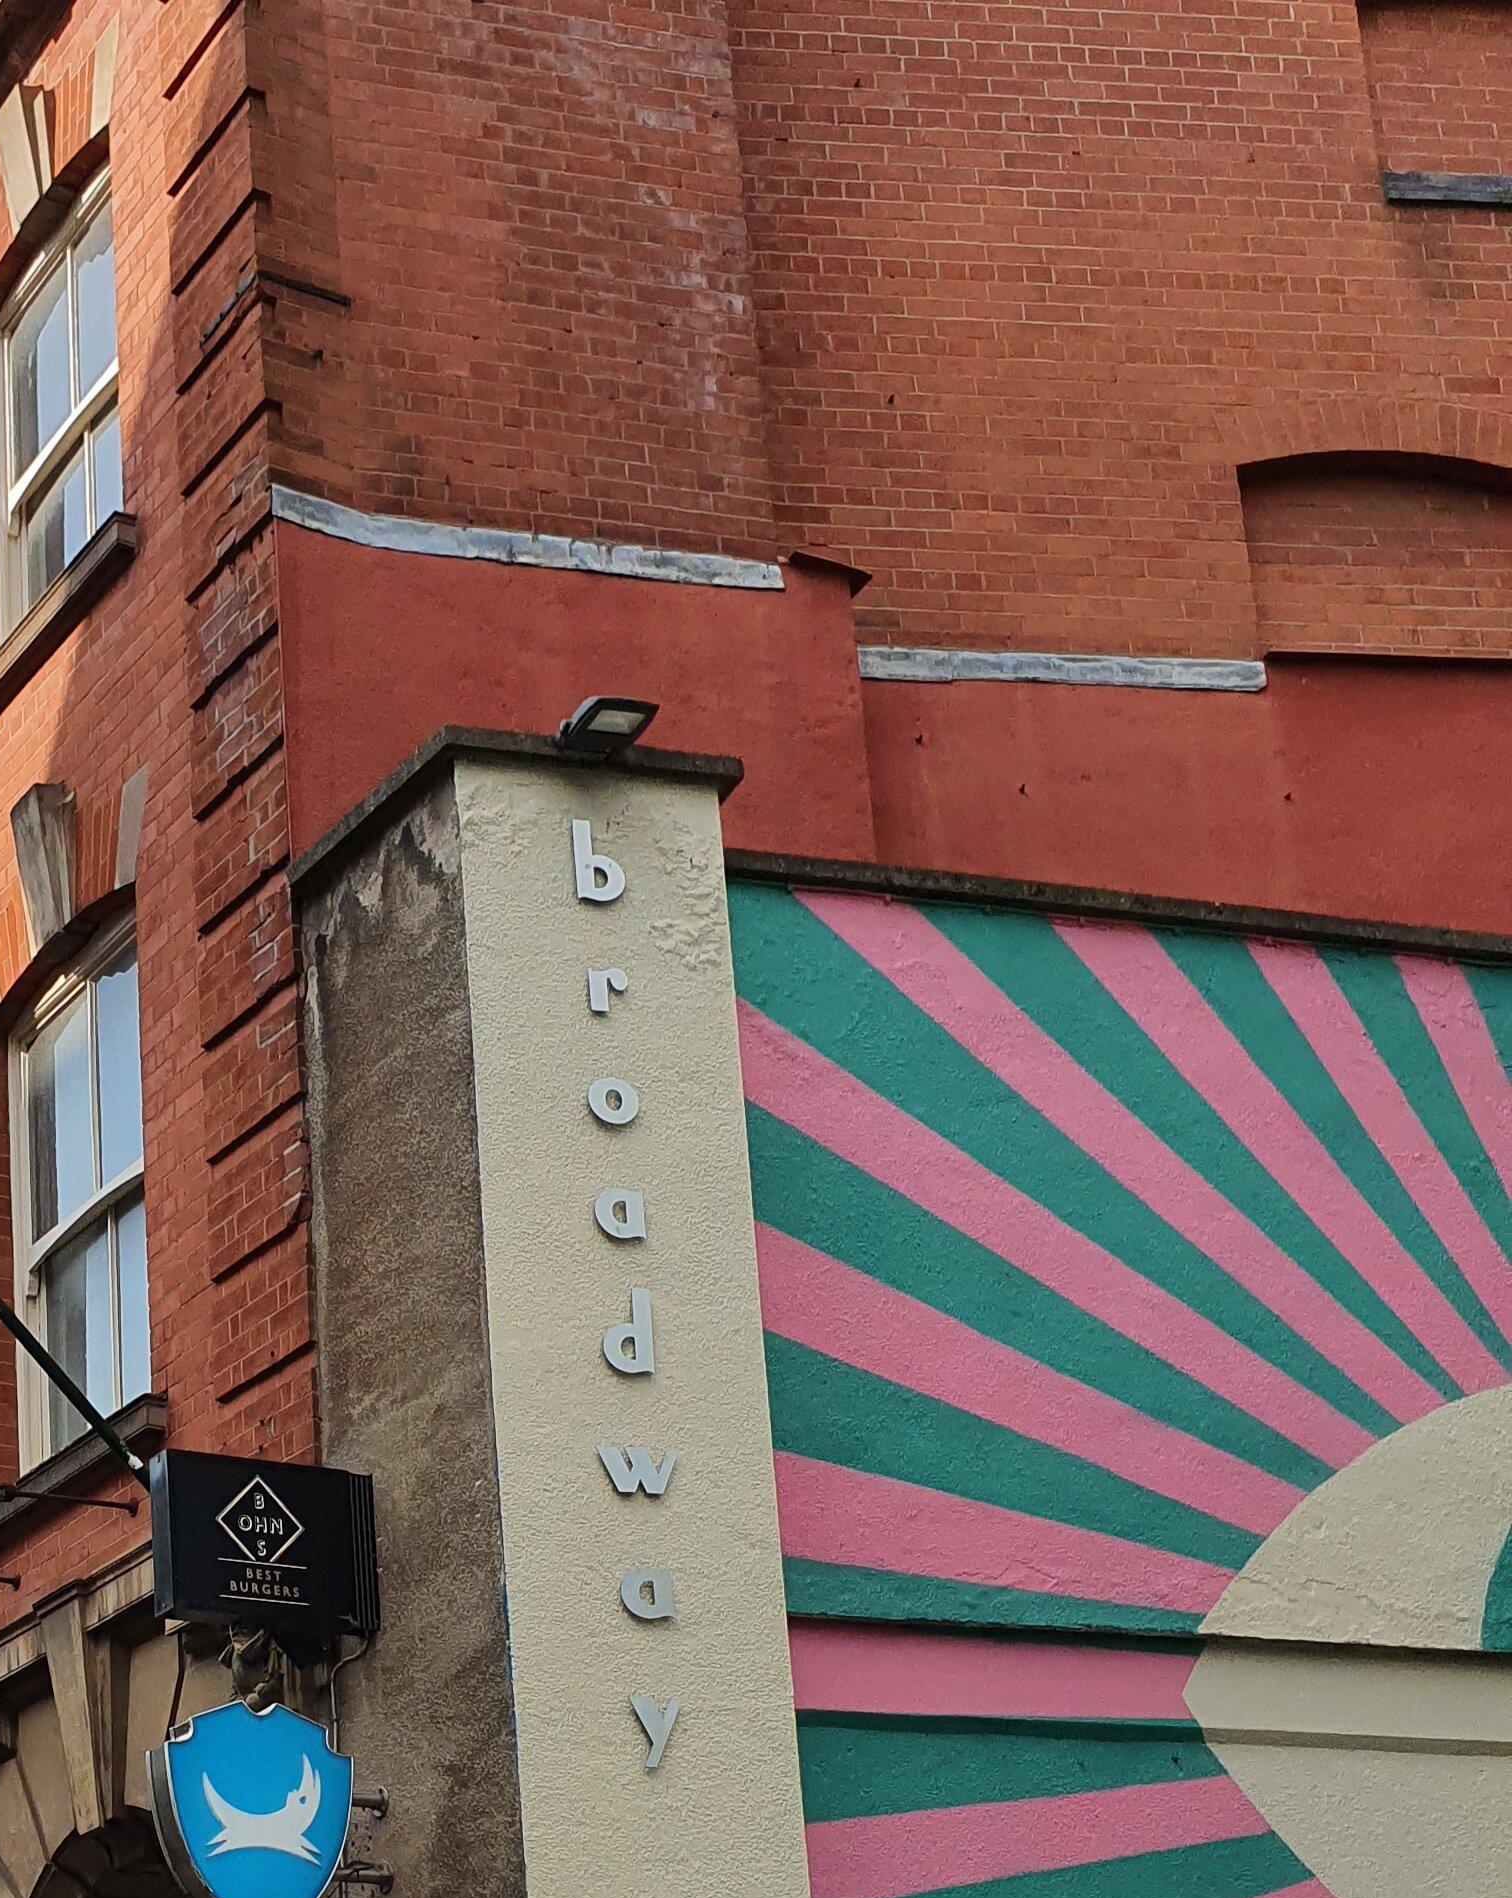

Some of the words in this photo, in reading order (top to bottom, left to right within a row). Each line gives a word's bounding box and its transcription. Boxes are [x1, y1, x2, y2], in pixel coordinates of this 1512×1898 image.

[571, 818, 680, 1769] broadway
[246, 1567, 282, 1582] BEST
[229, 1580, 300, 1598] BURGERS
